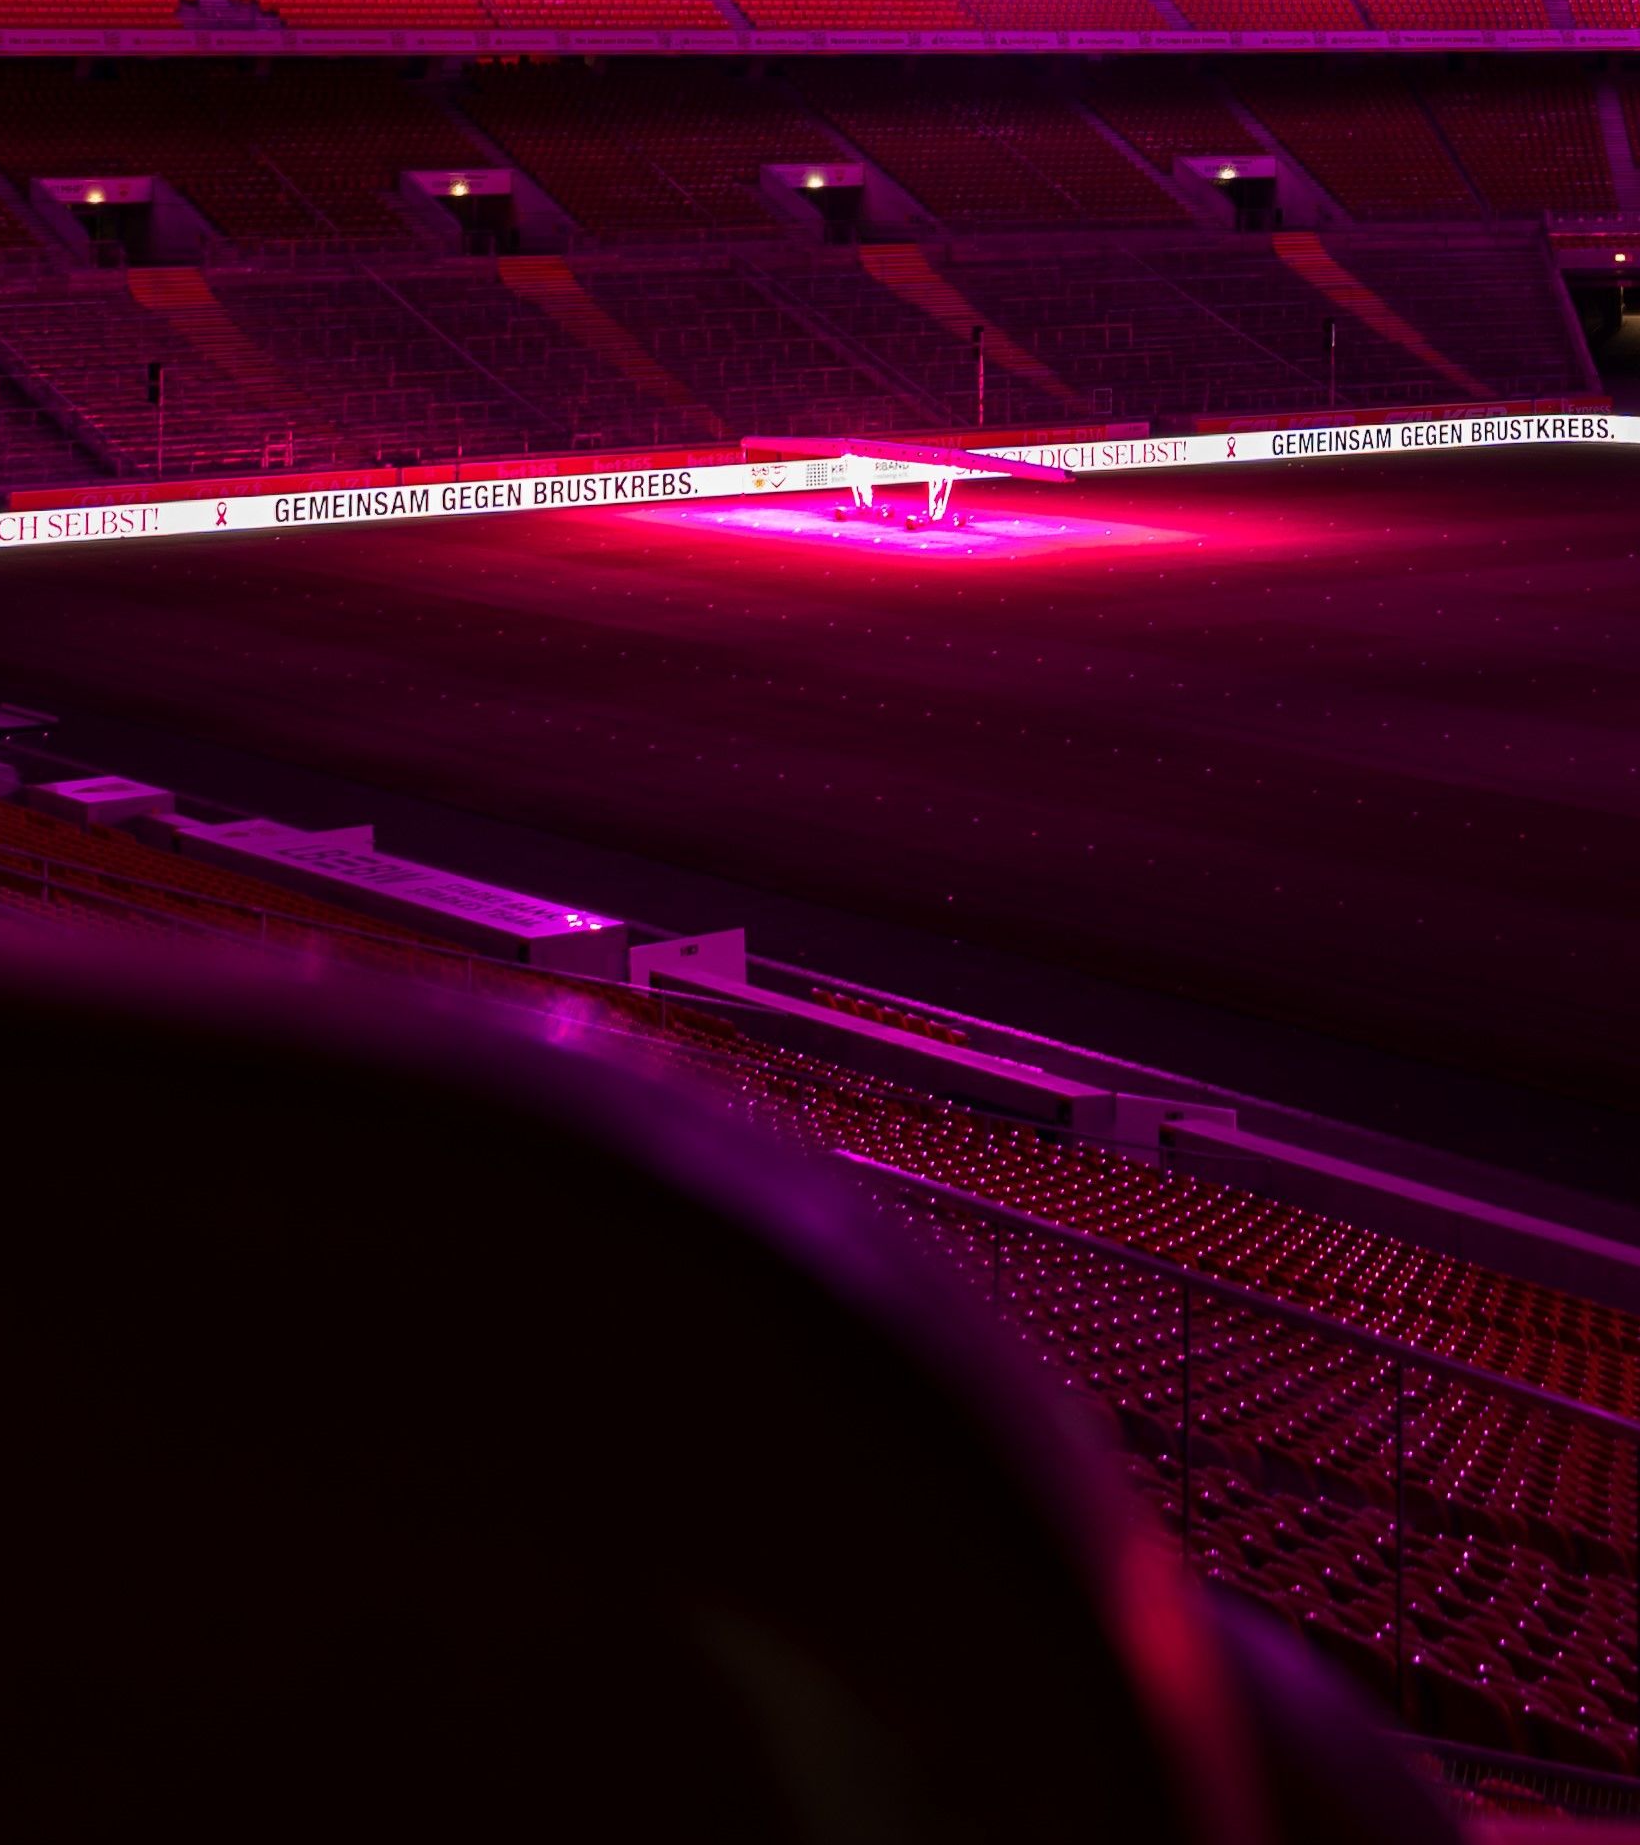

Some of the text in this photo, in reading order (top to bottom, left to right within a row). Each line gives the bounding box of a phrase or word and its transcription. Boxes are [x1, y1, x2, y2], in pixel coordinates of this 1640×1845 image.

[1037, 446, 1097, 469] DICH
[1102, 440, 1188, 465] SELBST!
[1272, 417, 1615, 456] GEMEINSAM GEGEN BRUSTKREBS.
[275, 471, 699, 523] GEMEINSAM GEGEN BRUSTKREBS.
[47, 506, 160, 539] SELBST!
